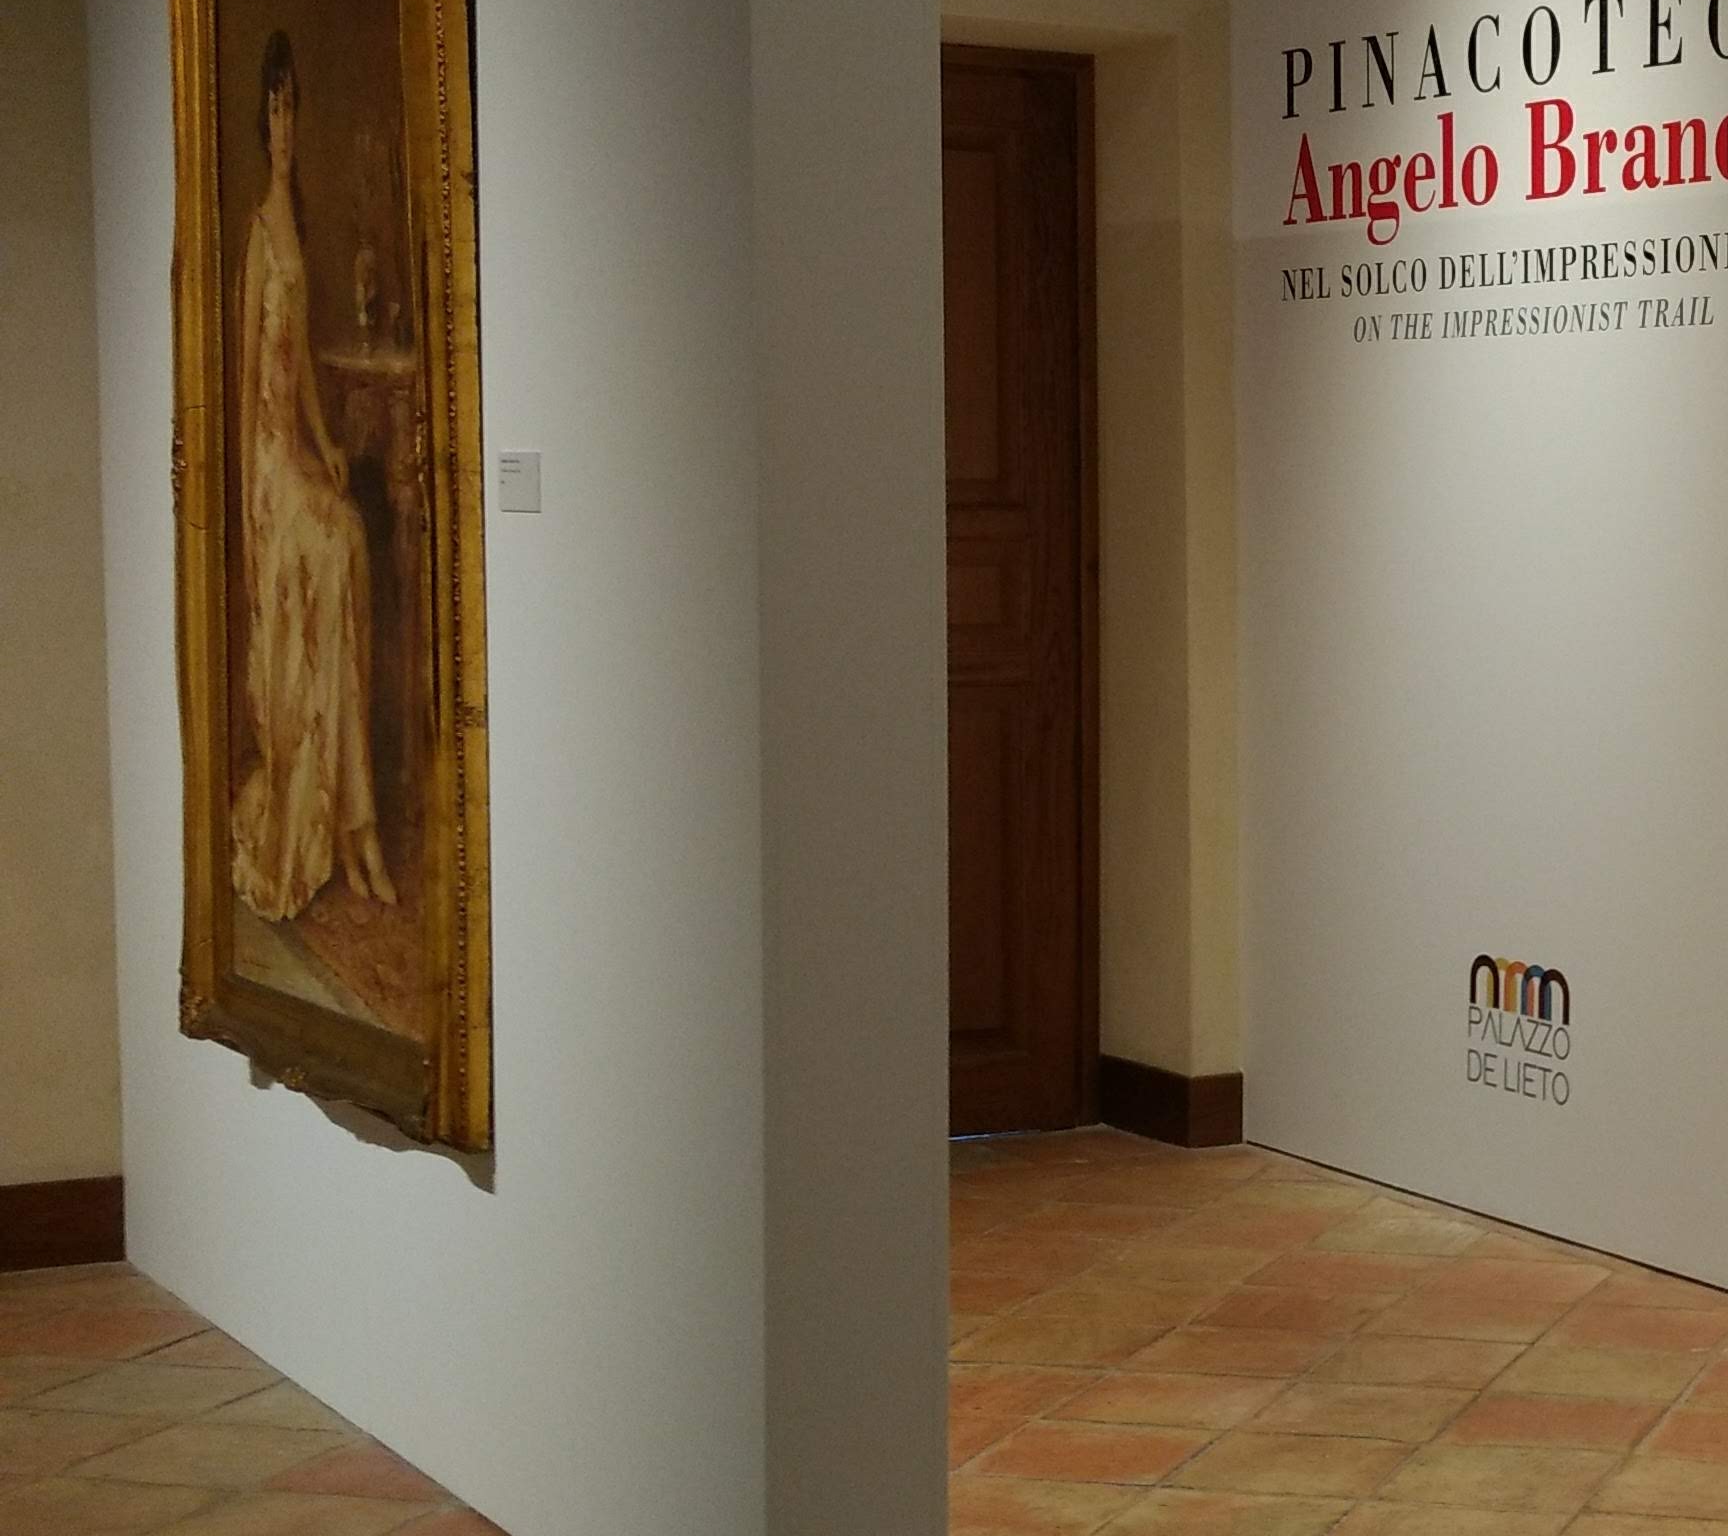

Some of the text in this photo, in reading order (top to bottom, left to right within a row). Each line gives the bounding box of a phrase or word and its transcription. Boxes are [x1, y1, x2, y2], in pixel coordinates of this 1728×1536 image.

[1283, 112, 1498, 246] Angelo
[1282, 266, 1331, 302] NEL
[1341, 258, 1428, 298] SOLCO
[1353, 295, 1715, 343] ON THE IMPRESSIONIST TRAIL
[1468, 1006, 1570, 1060] PALAZZO
[1467, 1049, 1570, 1105] DE LIETO
